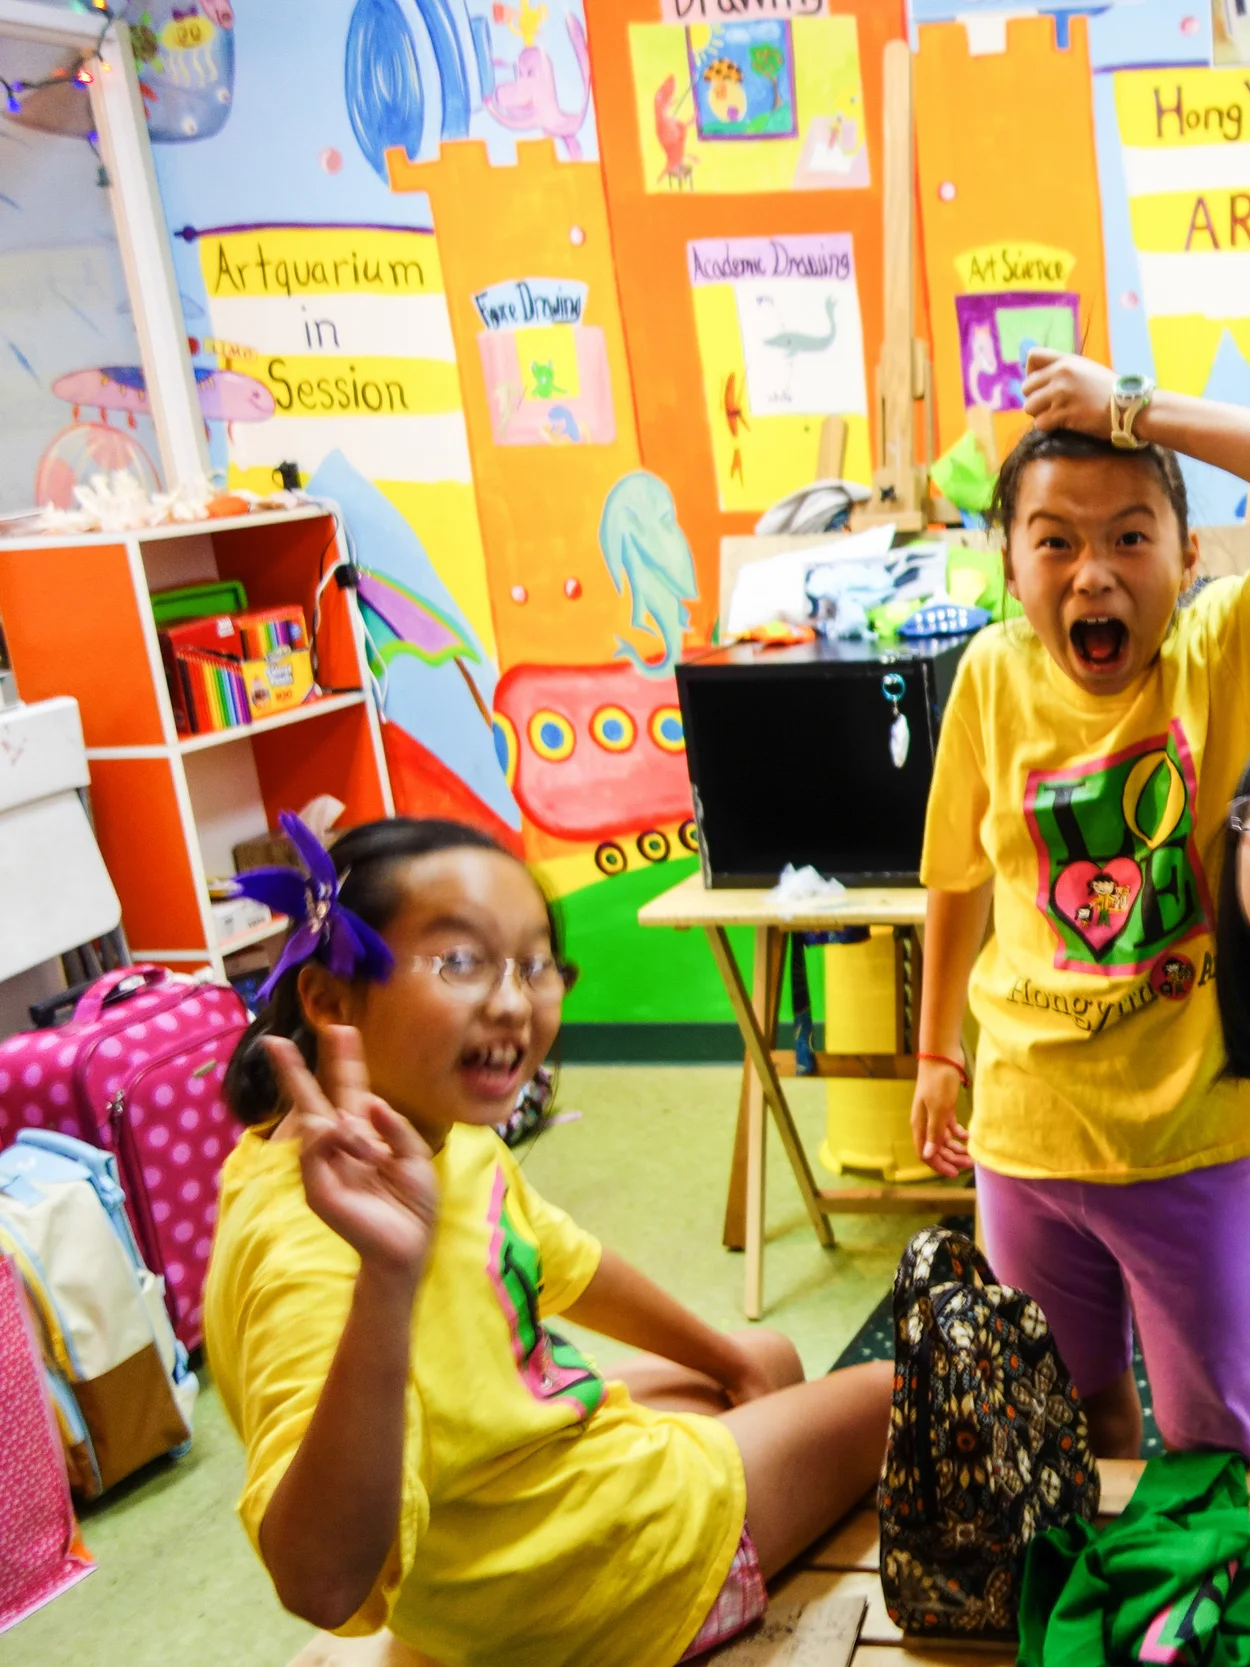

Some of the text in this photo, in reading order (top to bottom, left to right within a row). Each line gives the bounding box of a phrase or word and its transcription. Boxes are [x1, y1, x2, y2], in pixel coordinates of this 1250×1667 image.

[215, 241, 425, 297] Artquarium
[692, 238, 850, 283] Academic Drawing
[968, 248, 1064, 284] Art Science
[301, 304, 340, 349] in
[268, 357, 409, 411] Session
